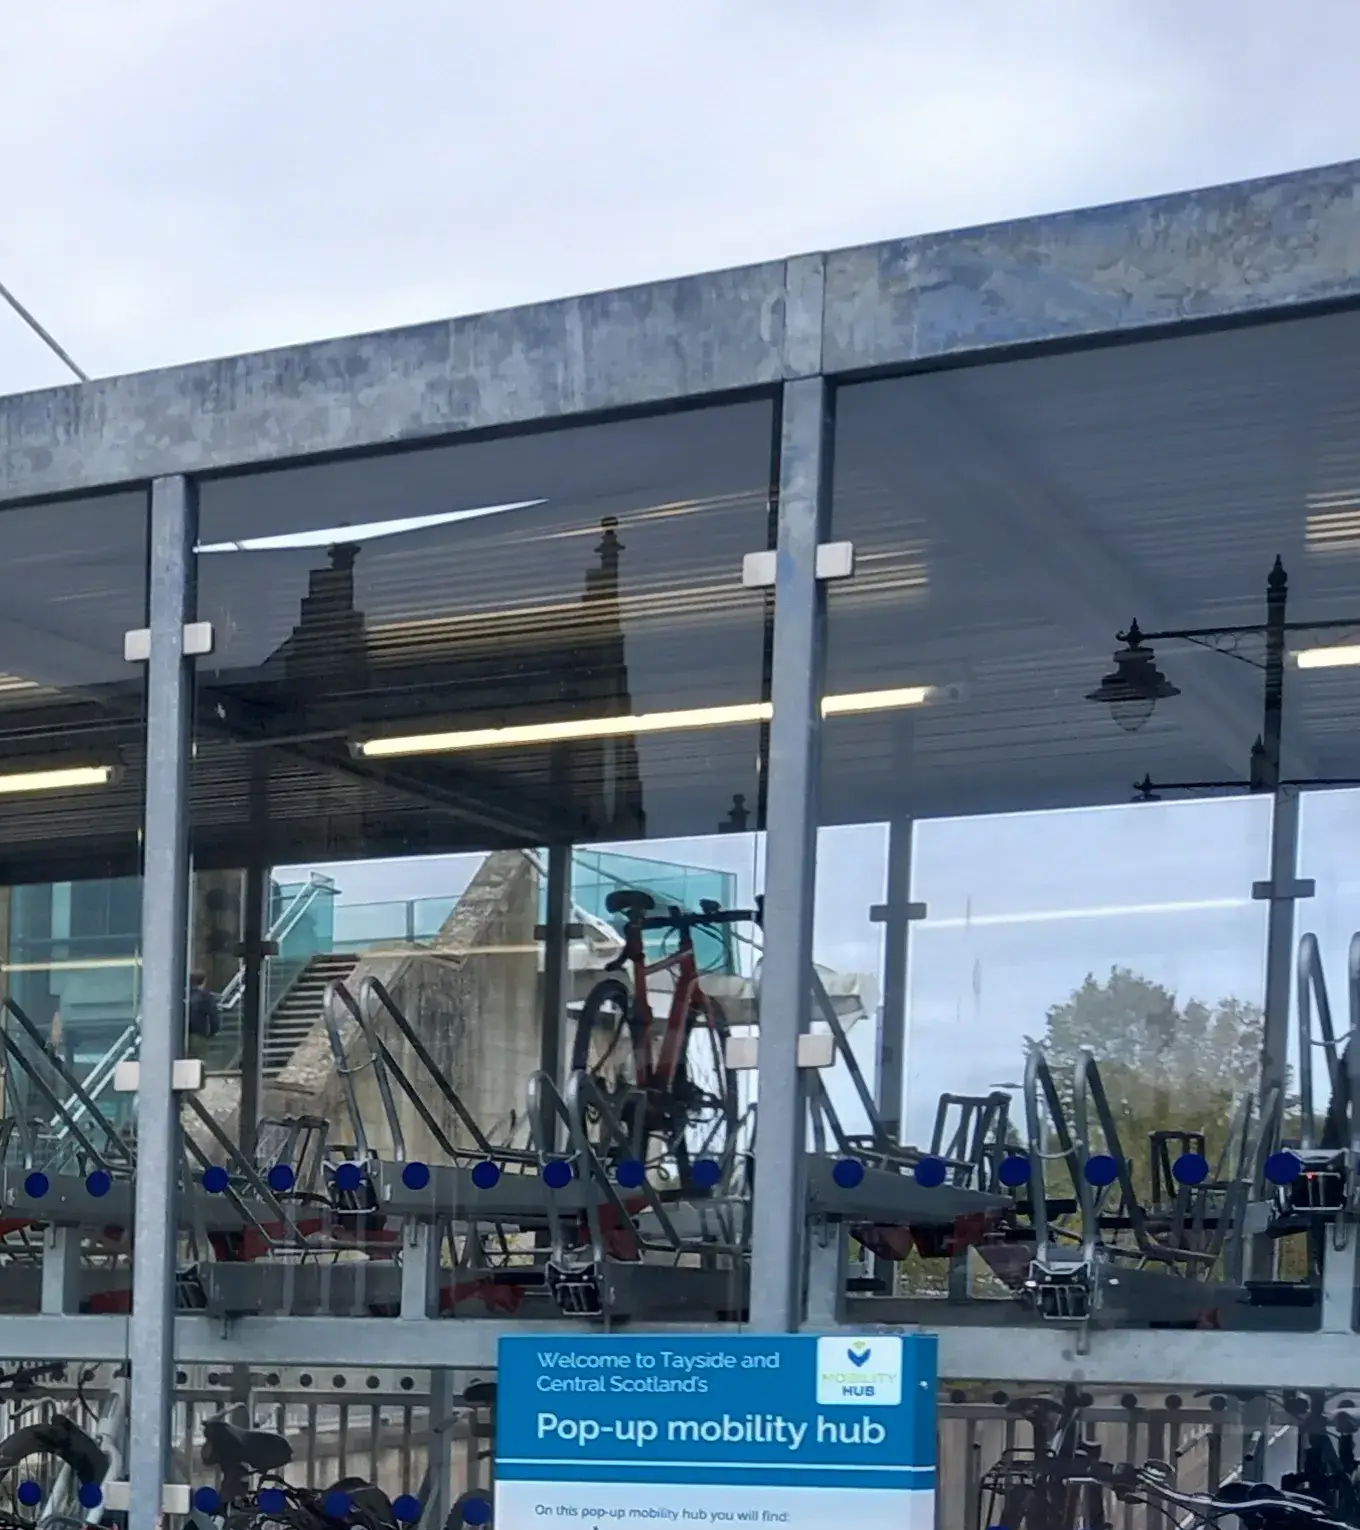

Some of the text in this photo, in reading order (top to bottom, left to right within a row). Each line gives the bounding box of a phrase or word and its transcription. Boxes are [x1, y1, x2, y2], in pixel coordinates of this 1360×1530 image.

[536, 1352, 780, 1374] Welcome to Tayside and
[536, 1375, 708, 1392] Central Scotland's
[822, 1372, 897, 1385] MOBILITY
[842, 1385, 876, 1397] HUB
[537, 1411, 886, 1450] Pop-up mobility hub
[534, 1504, 553, 1516] On
[555, 1504, 578, 1516] this
[581, 1508, 625, 1521] pop-up
[628, 1507, 679, 1522] mobility
[681, 1508, 707, 1520] hub
[710, 1512, 734, 1523] you
[736, 1510, 758, 1522] will
